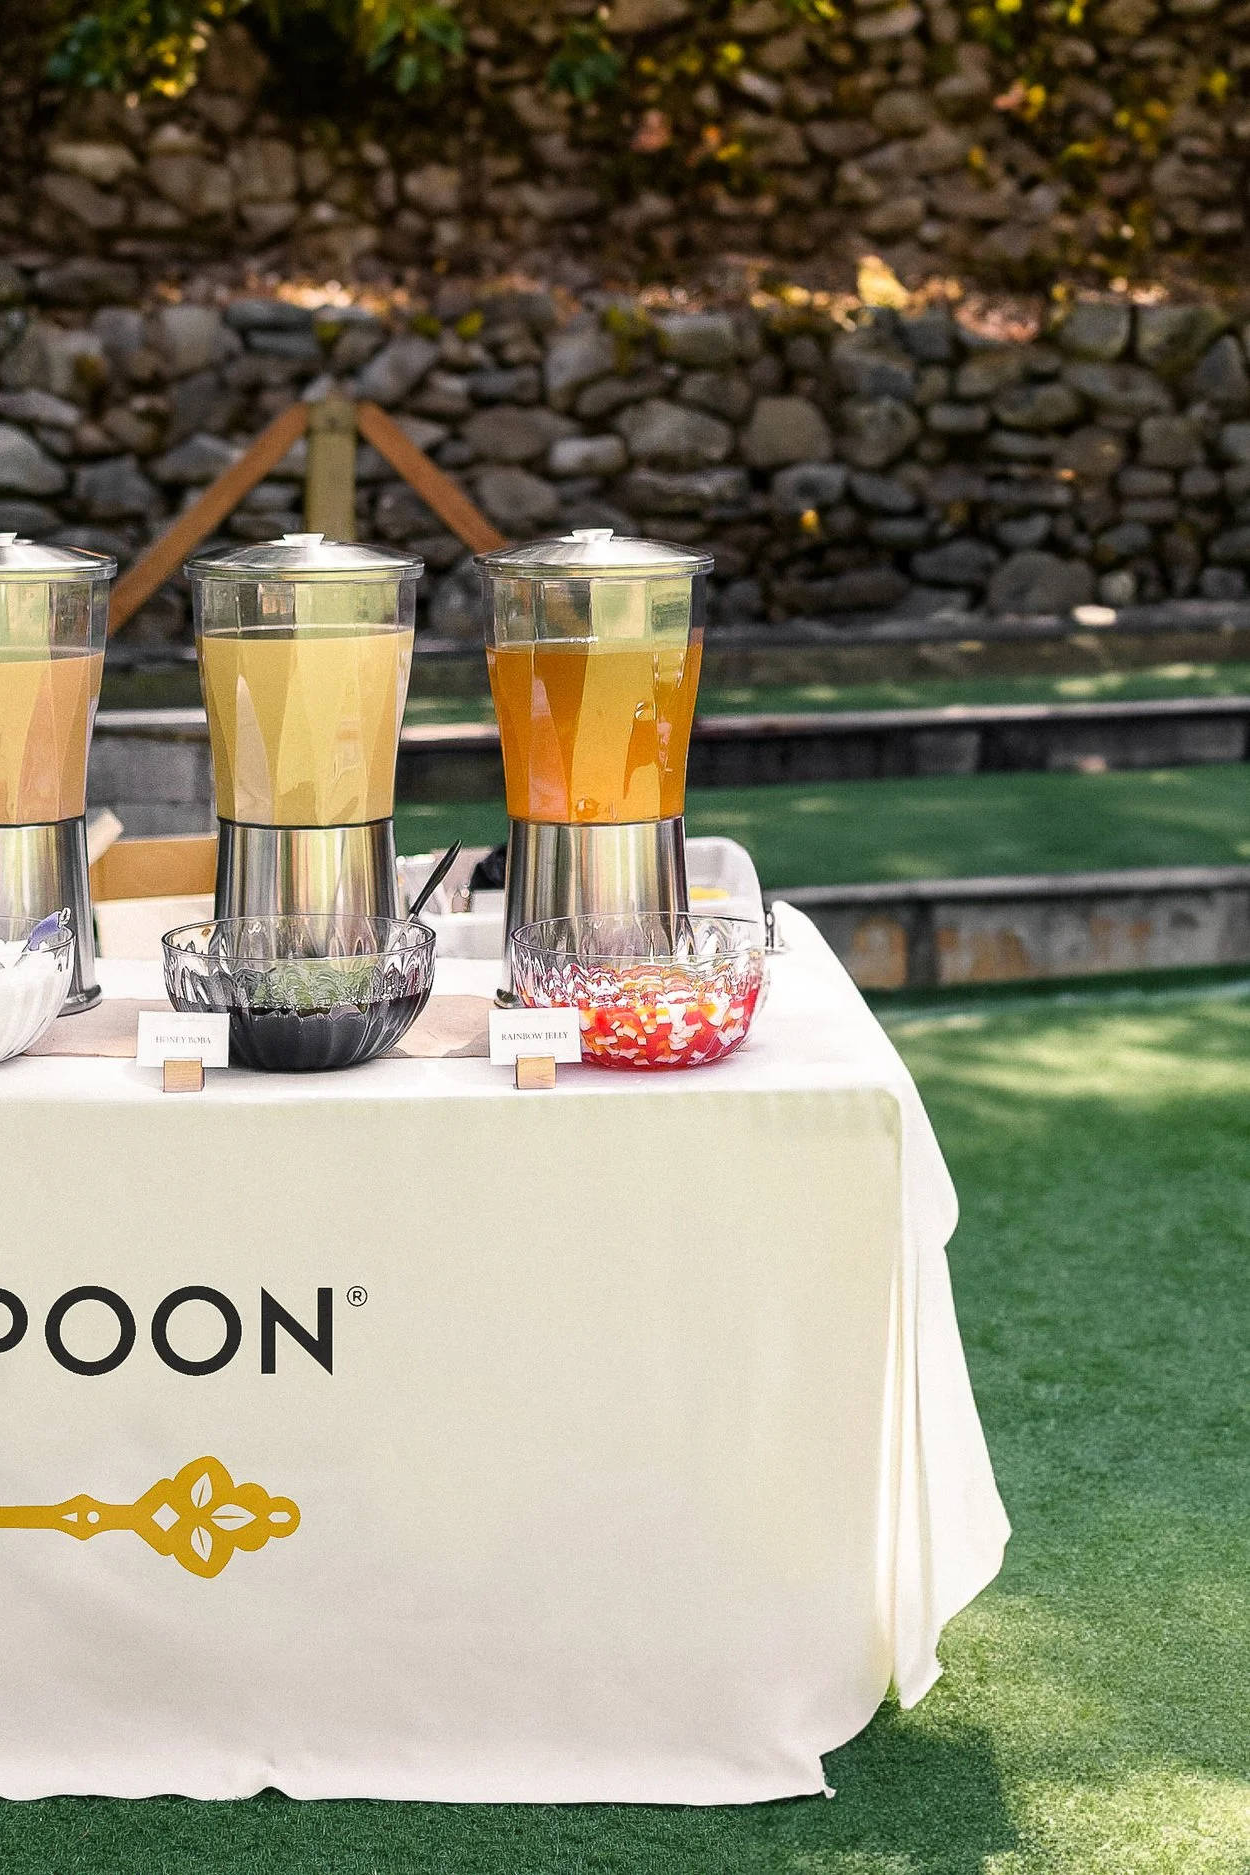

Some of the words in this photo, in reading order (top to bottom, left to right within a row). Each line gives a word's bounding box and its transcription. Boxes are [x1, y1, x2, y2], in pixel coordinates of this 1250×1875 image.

[155, 1035, 186, 1044] HONEY
[188, 1036, 211, 1044] BOBA
[501, 1031, 544, 1041] RAINBOW
[545, 1031, 569, 1041] JELLY
